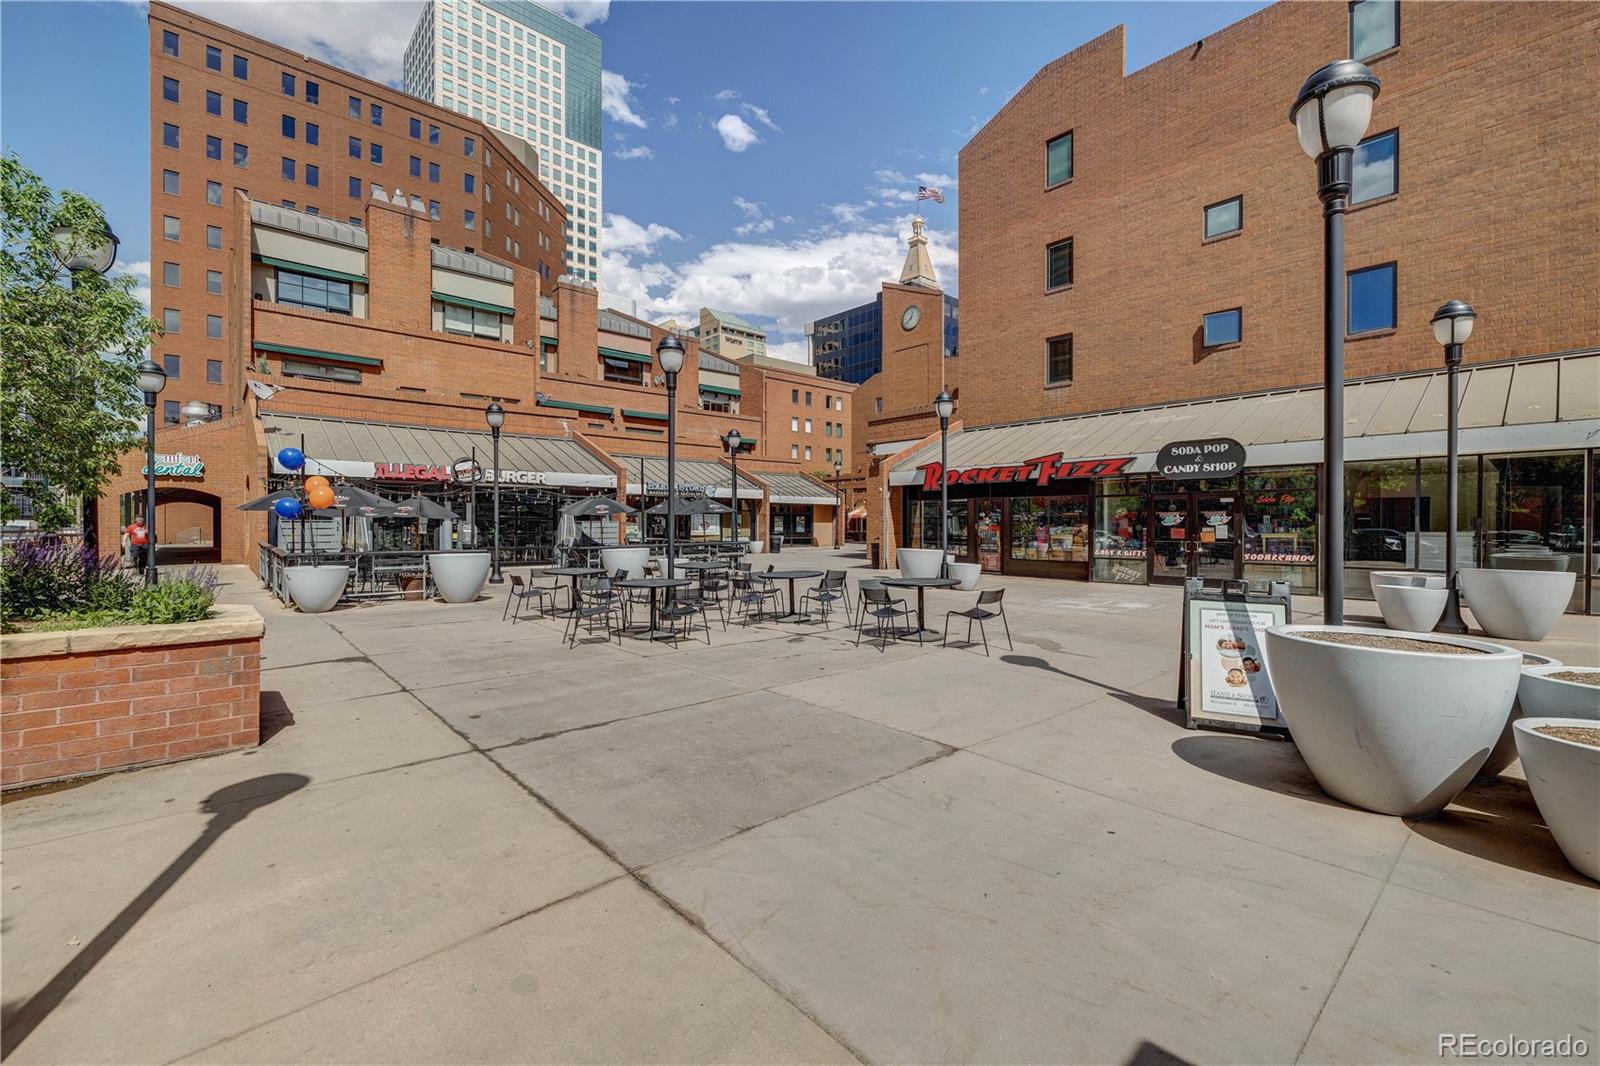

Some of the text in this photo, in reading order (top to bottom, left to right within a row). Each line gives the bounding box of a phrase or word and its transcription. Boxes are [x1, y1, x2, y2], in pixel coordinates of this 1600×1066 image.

[1171, 443, 1229, 455] SODA POP
[375, 463, 452, 481] ILLEGAL
[917, 452, 1138, 491] ROCKET FIZZ
[1164, 462, 1237, 474] CANDY SHOP
